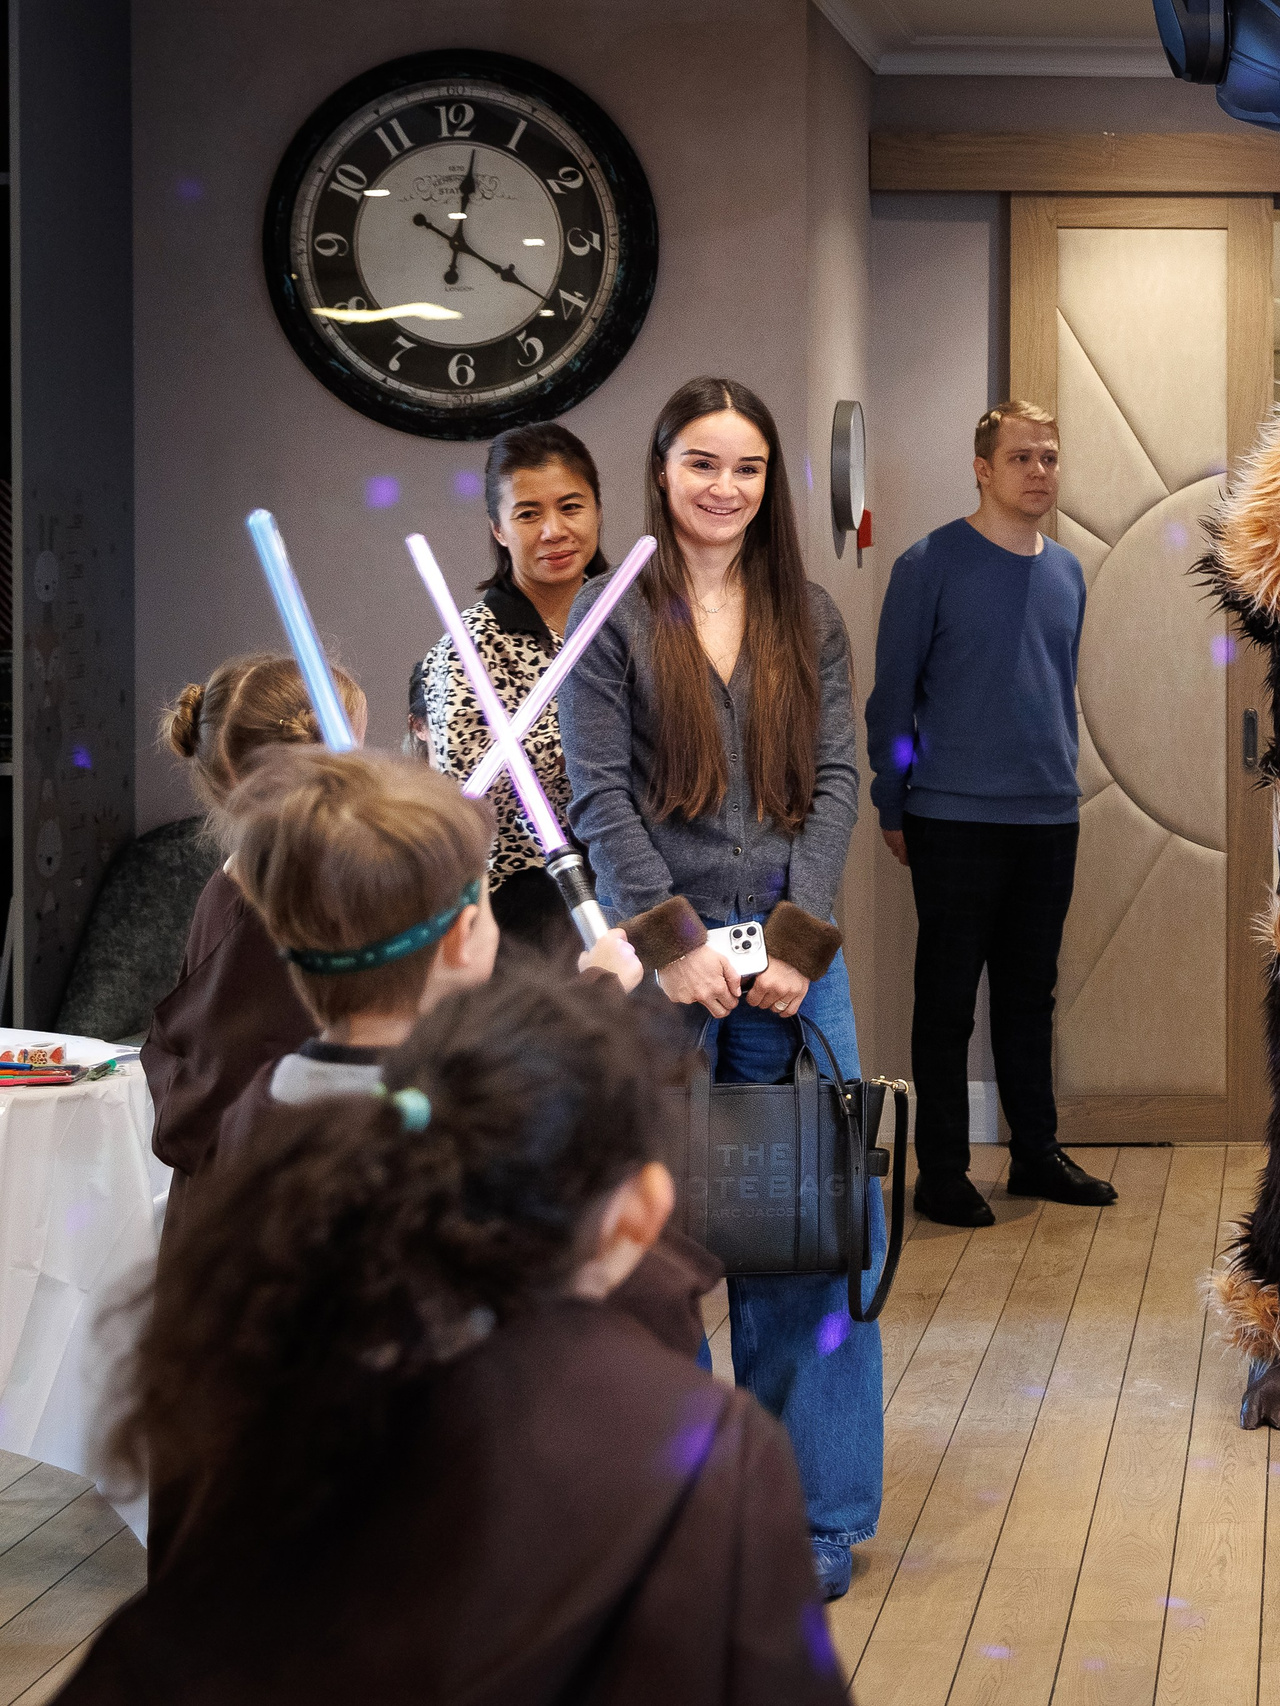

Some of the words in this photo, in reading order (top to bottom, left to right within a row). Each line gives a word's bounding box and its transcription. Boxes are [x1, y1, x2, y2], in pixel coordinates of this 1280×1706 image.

[434, 103, 477, 138] 12
[505, 119, 528, 153] 1
[374, 118, 415, 159] 11
[330, 163, 368, 203] 10
[546, 166, 584, 194] 2
[314, 232, 349, 257] 9
[567, 227, 602, 256] 3
[558, 289, 591, 320] 4
[388, 336, 418, 372] 7
[516, 331, 544, 368] 5
[448, 353, 476, 386] 6
[716, 1142, 792, 1167] THE
[688, 1174, 760, 1199] OTE
[768, 1173, 846, 1198] BAG
